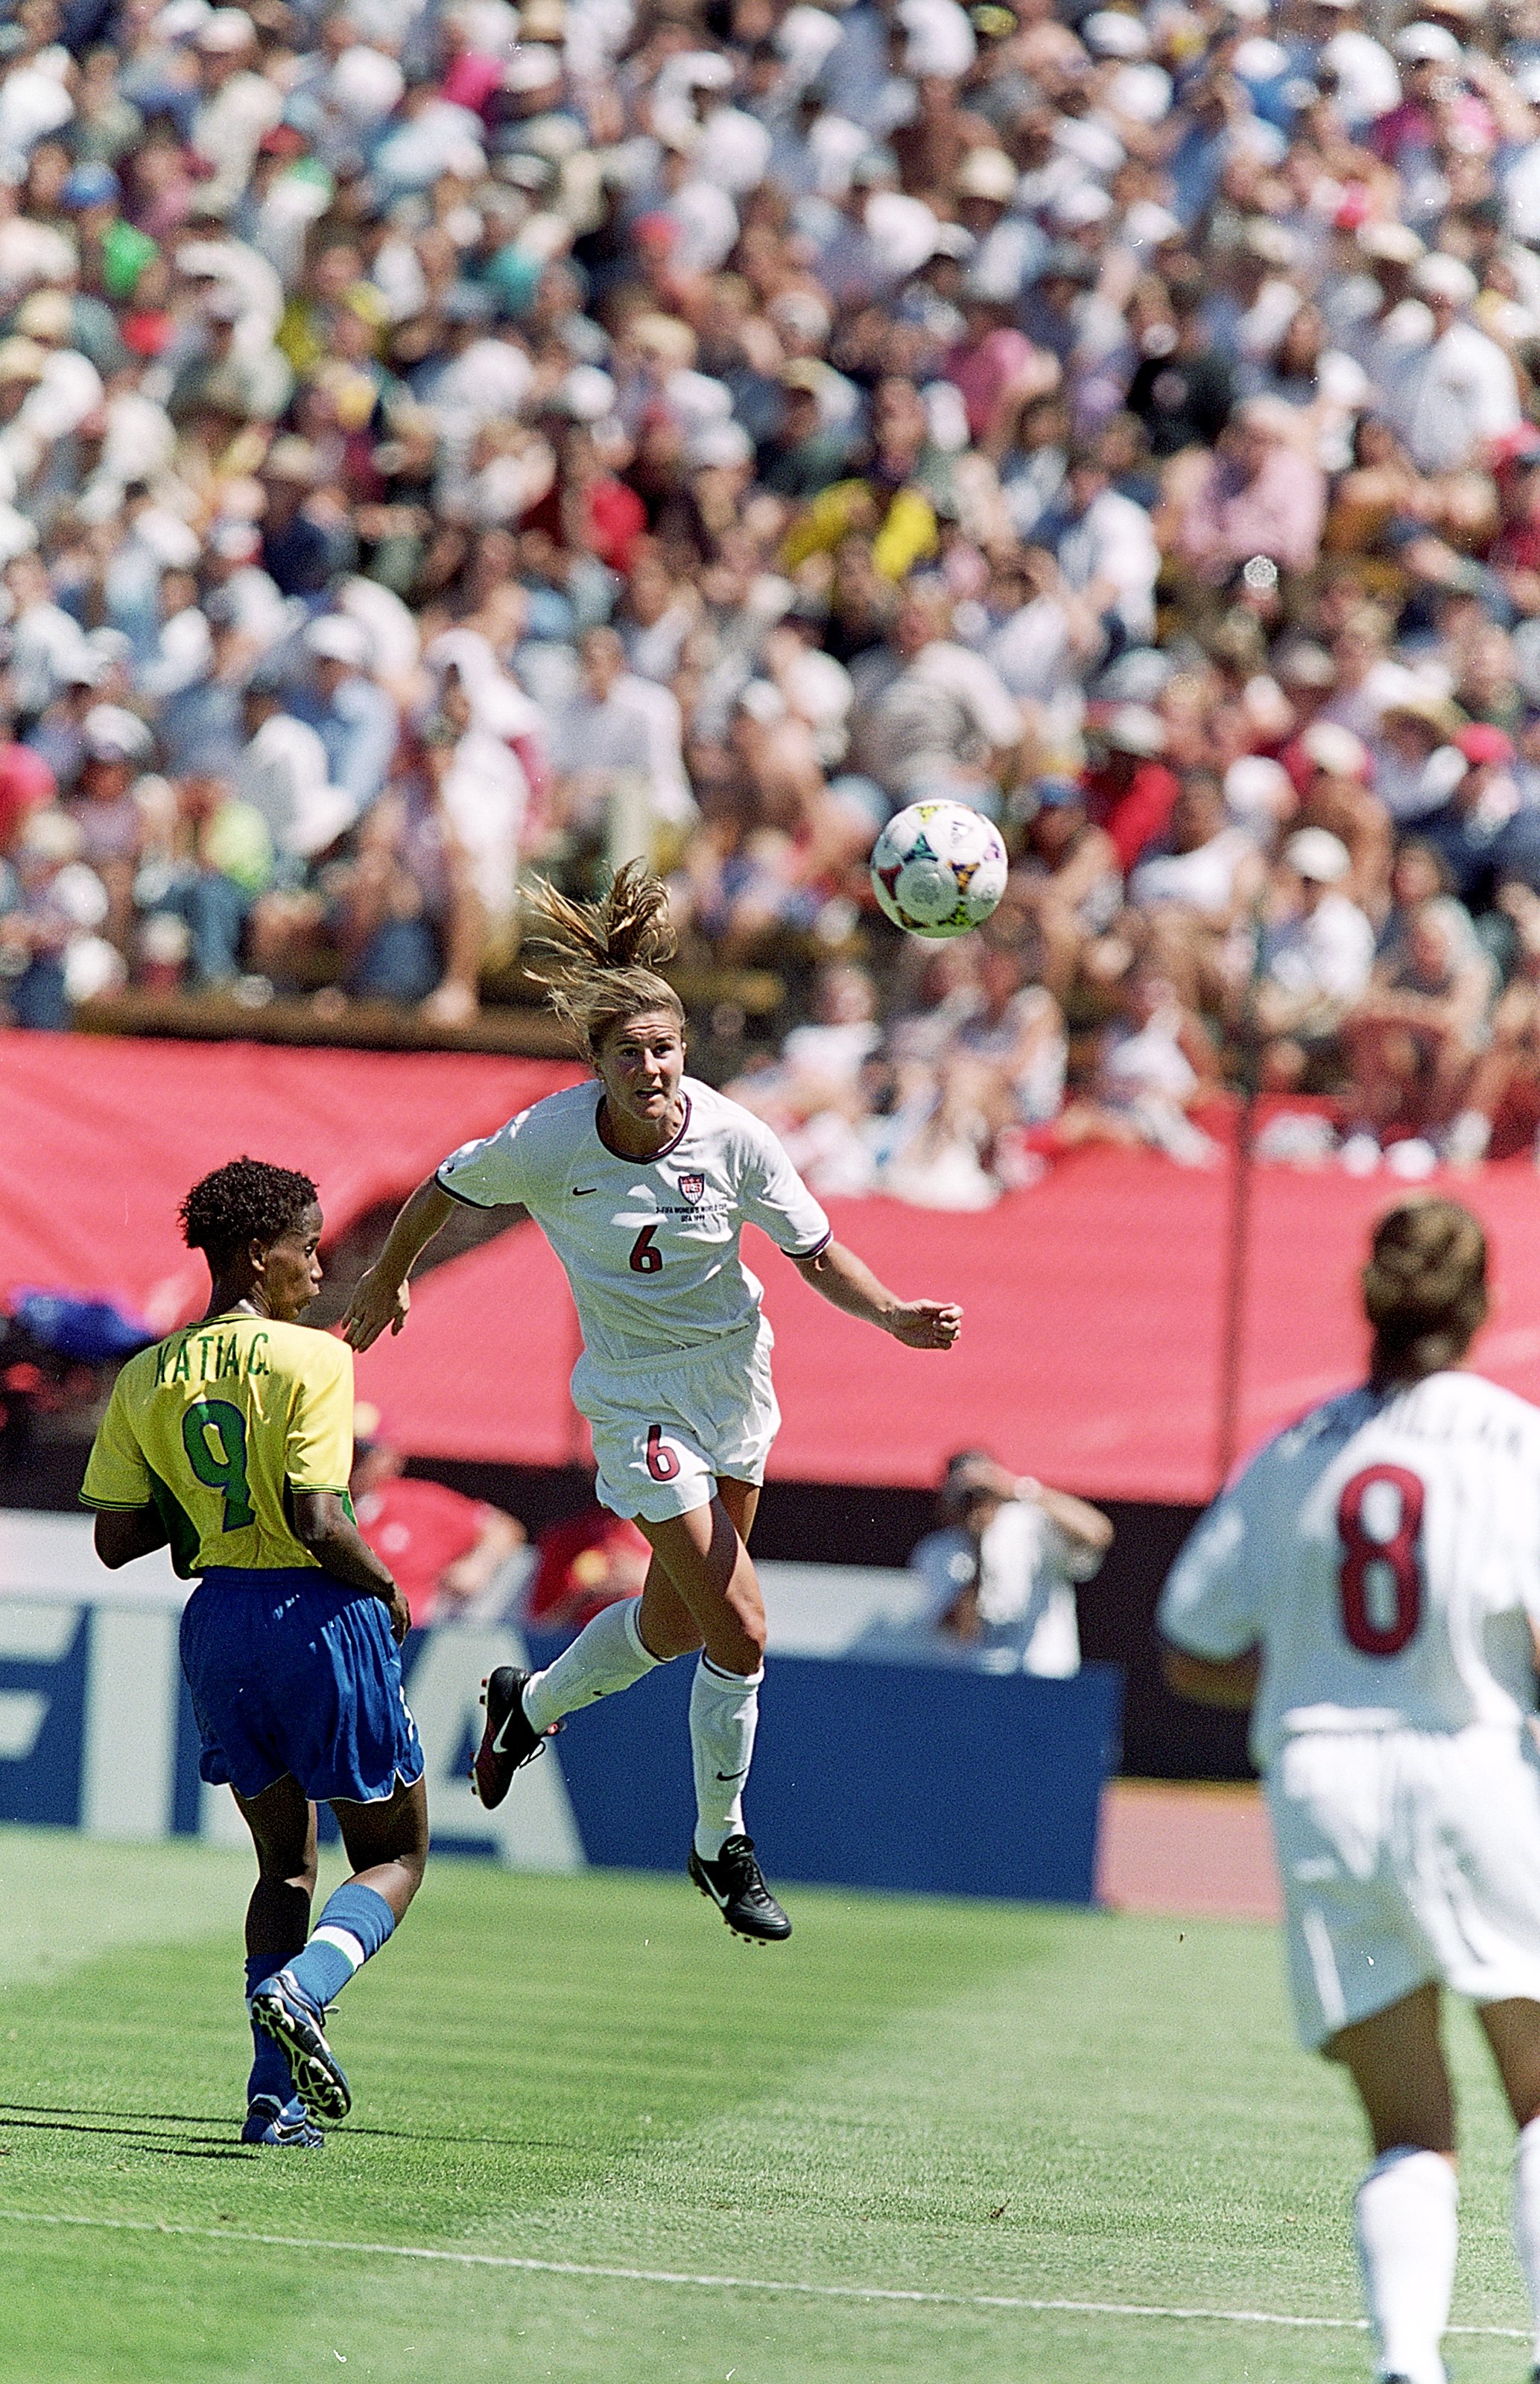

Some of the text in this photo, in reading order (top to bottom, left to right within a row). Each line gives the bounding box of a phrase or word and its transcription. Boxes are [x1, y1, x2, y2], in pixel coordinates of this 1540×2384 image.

[681, 1214, 692, 1223] USA
[630, 1225, 663, 1274] 6
[181, 1398, 256, 1533] 9
[646, 1424, 681, 1483] 6
[1337, 1462, 1427, 1656] 8
